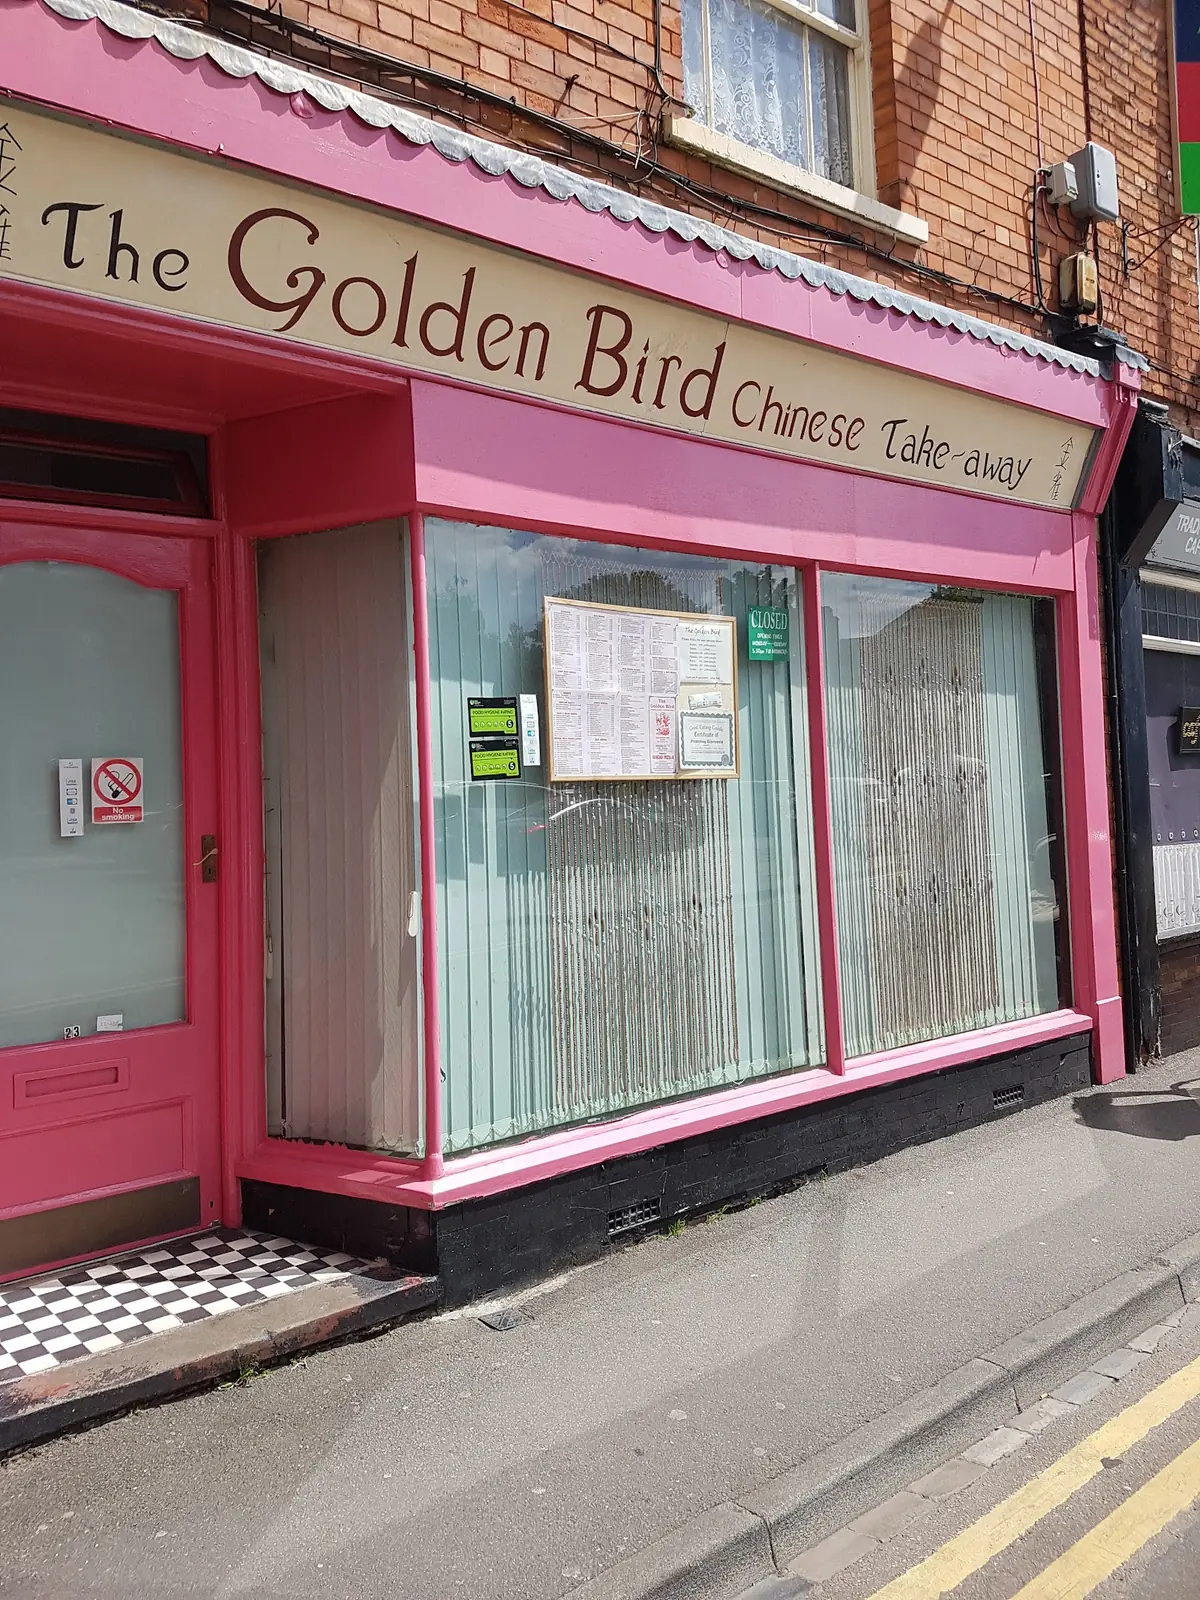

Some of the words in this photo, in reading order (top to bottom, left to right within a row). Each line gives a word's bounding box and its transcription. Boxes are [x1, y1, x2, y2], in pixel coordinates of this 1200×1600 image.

[41, 202, 190, 291] The
[227, 207, 550, 381] Golden
[574, 303, 727, 421] Bird
[731, 380, 865, 453] Chinese
[751, 610, 788, 630] CLOSED
[102, 813, 135, 821] smoking
[66, 1026, 79, 1038] 23
